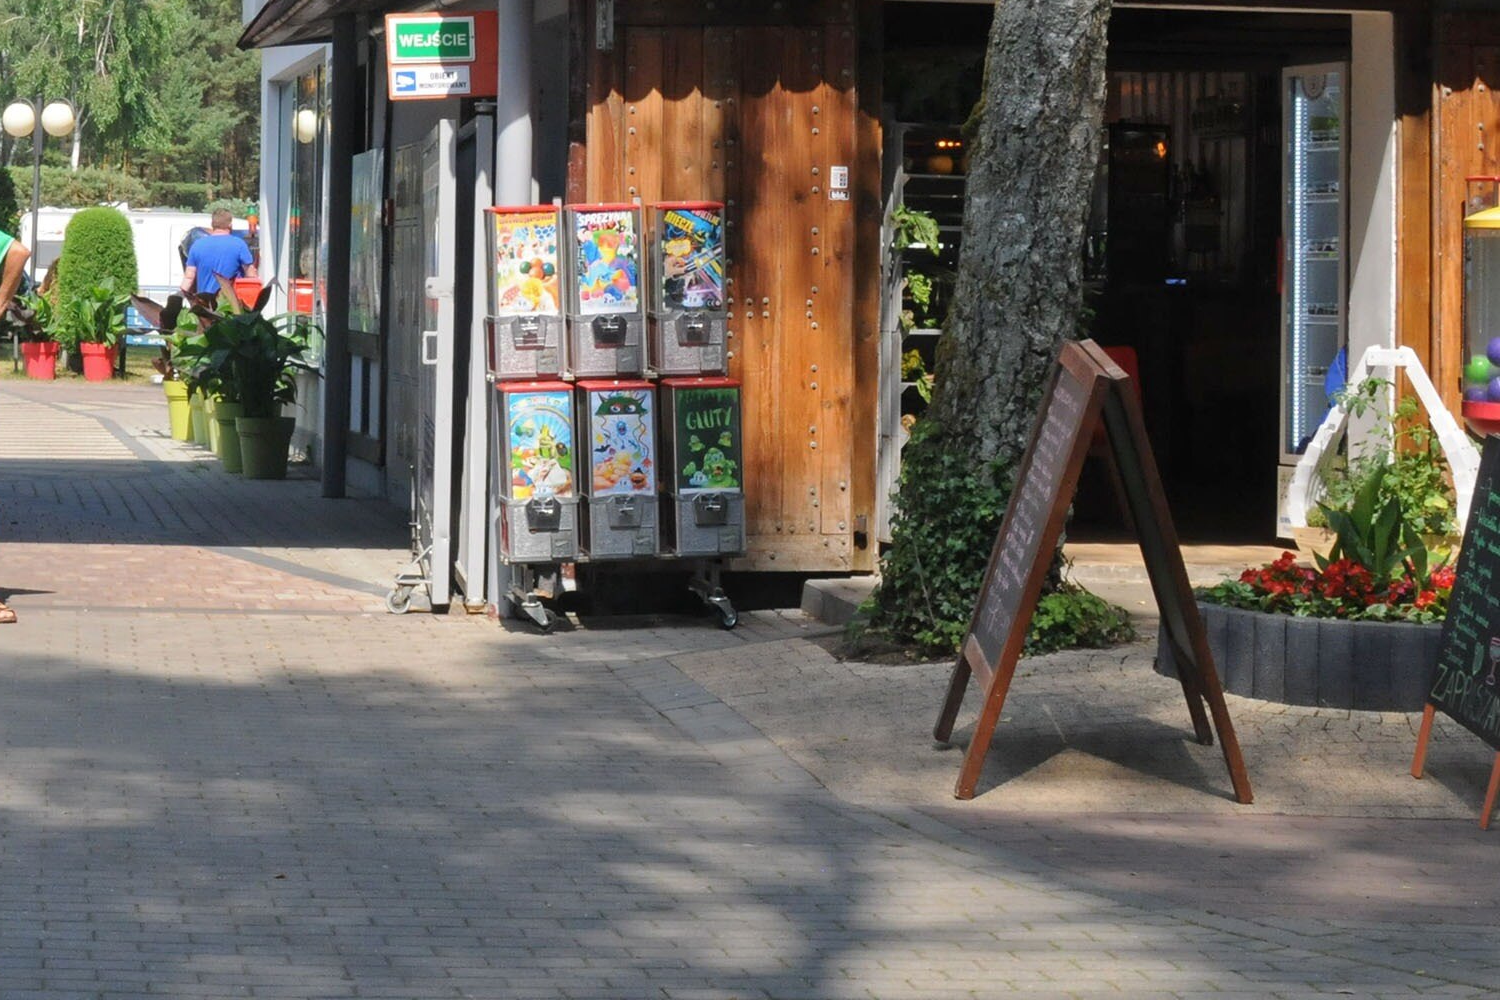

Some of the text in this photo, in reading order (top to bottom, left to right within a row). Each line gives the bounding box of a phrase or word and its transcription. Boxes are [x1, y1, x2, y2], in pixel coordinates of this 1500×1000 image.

[398, 30, 467, 48] WEJŚCIE
[430, 71, 454, 81] OBIEKT
[686, 406, 733, 430] GLUTY
